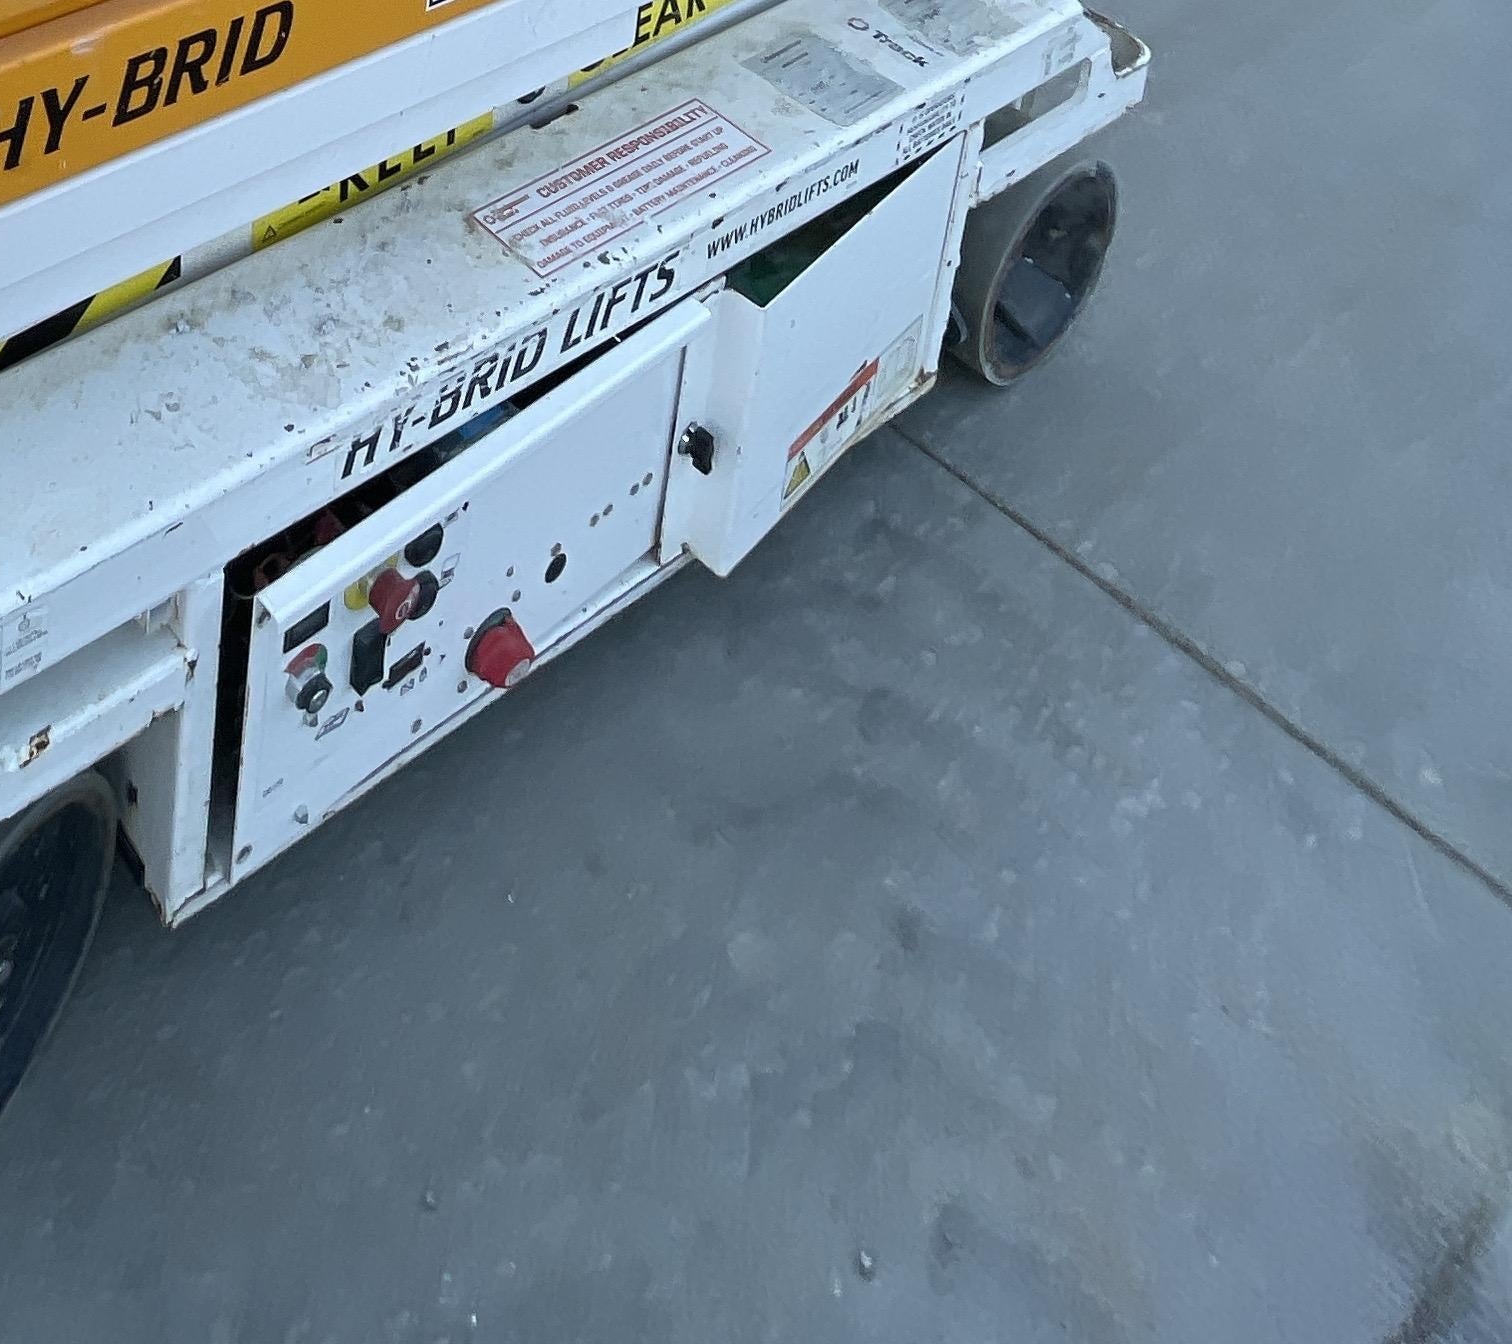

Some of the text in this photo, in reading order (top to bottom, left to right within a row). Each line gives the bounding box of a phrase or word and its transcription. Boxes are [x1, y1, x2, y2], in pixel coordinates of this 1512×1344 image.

[535, 104, 709, 198] CUSTOMER RESPONSIBILITY
[538, 215, 557, 228] ALL
[569, 238, 585, 250] TO
[706, 158, 861, 260] WWW.HYBRIDLIFTS.COM
[558, 248, 684, 357] LIFTS
